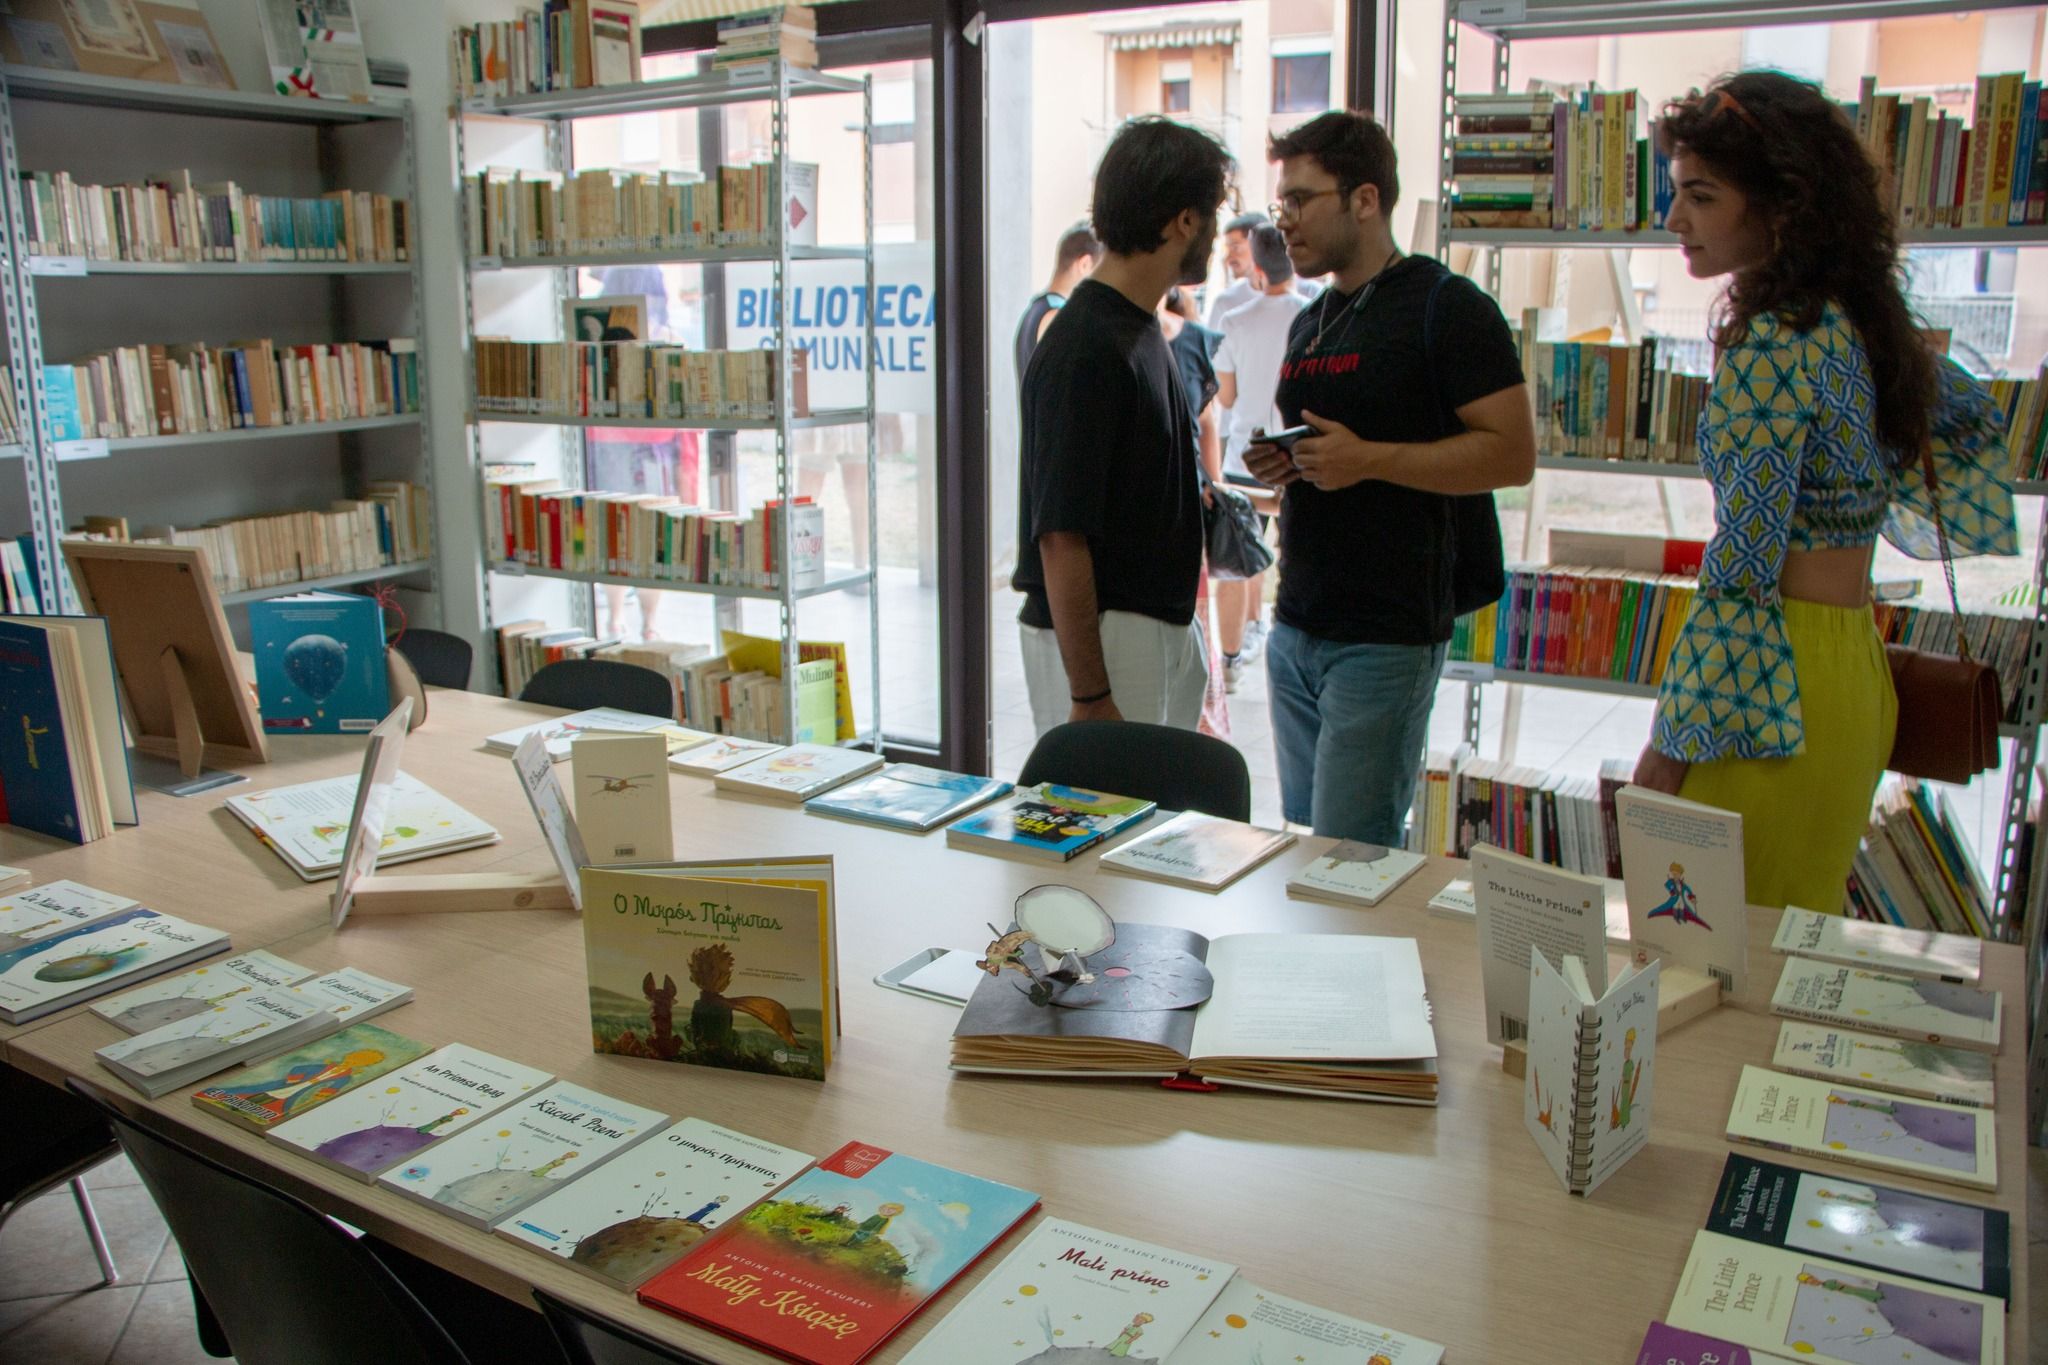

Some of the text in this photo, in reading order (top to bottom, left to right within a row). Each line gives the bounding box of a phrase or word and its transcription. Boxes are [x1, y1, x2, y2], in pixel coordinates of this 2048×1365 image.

[736, 284, 936, 328] BILIOTECA
[758, 336, 926, 372] MUNALE
[1488, 880, 1583, 916] The Little Prince
[423, 1065, 441, 1073] An
[438, 1069, 477, 1088] Prionsa
[476, 1083, 506, 1098] Beag
[530, 1099, 626, 1139] Küçük Prens
[1756, 1085, 1780, 1124] The Little
[1779, 1095, 1800, 1123] Prince
[677, 1139, 720, 1158] μικρός
[719, 1153, 781, 1179] Πρίγκιπας
[1730, 1166, 1761, 1228] The Little Prince
[1051, 1228, 1103, 1245] ANTOINE
[1105, 1242, 1121, 1250] DE
[724, 1253, 769, 1273] ANTOINE
[772, 1269, 787, 1278] DE
[1057, 1247, 1171, 1289] Mali princ
[1704, 1256, 1740, 1314] The Little
[686, 1262, 860, 1340] Mały Książę
[1734, 1271, 1762, 1312] Prince
